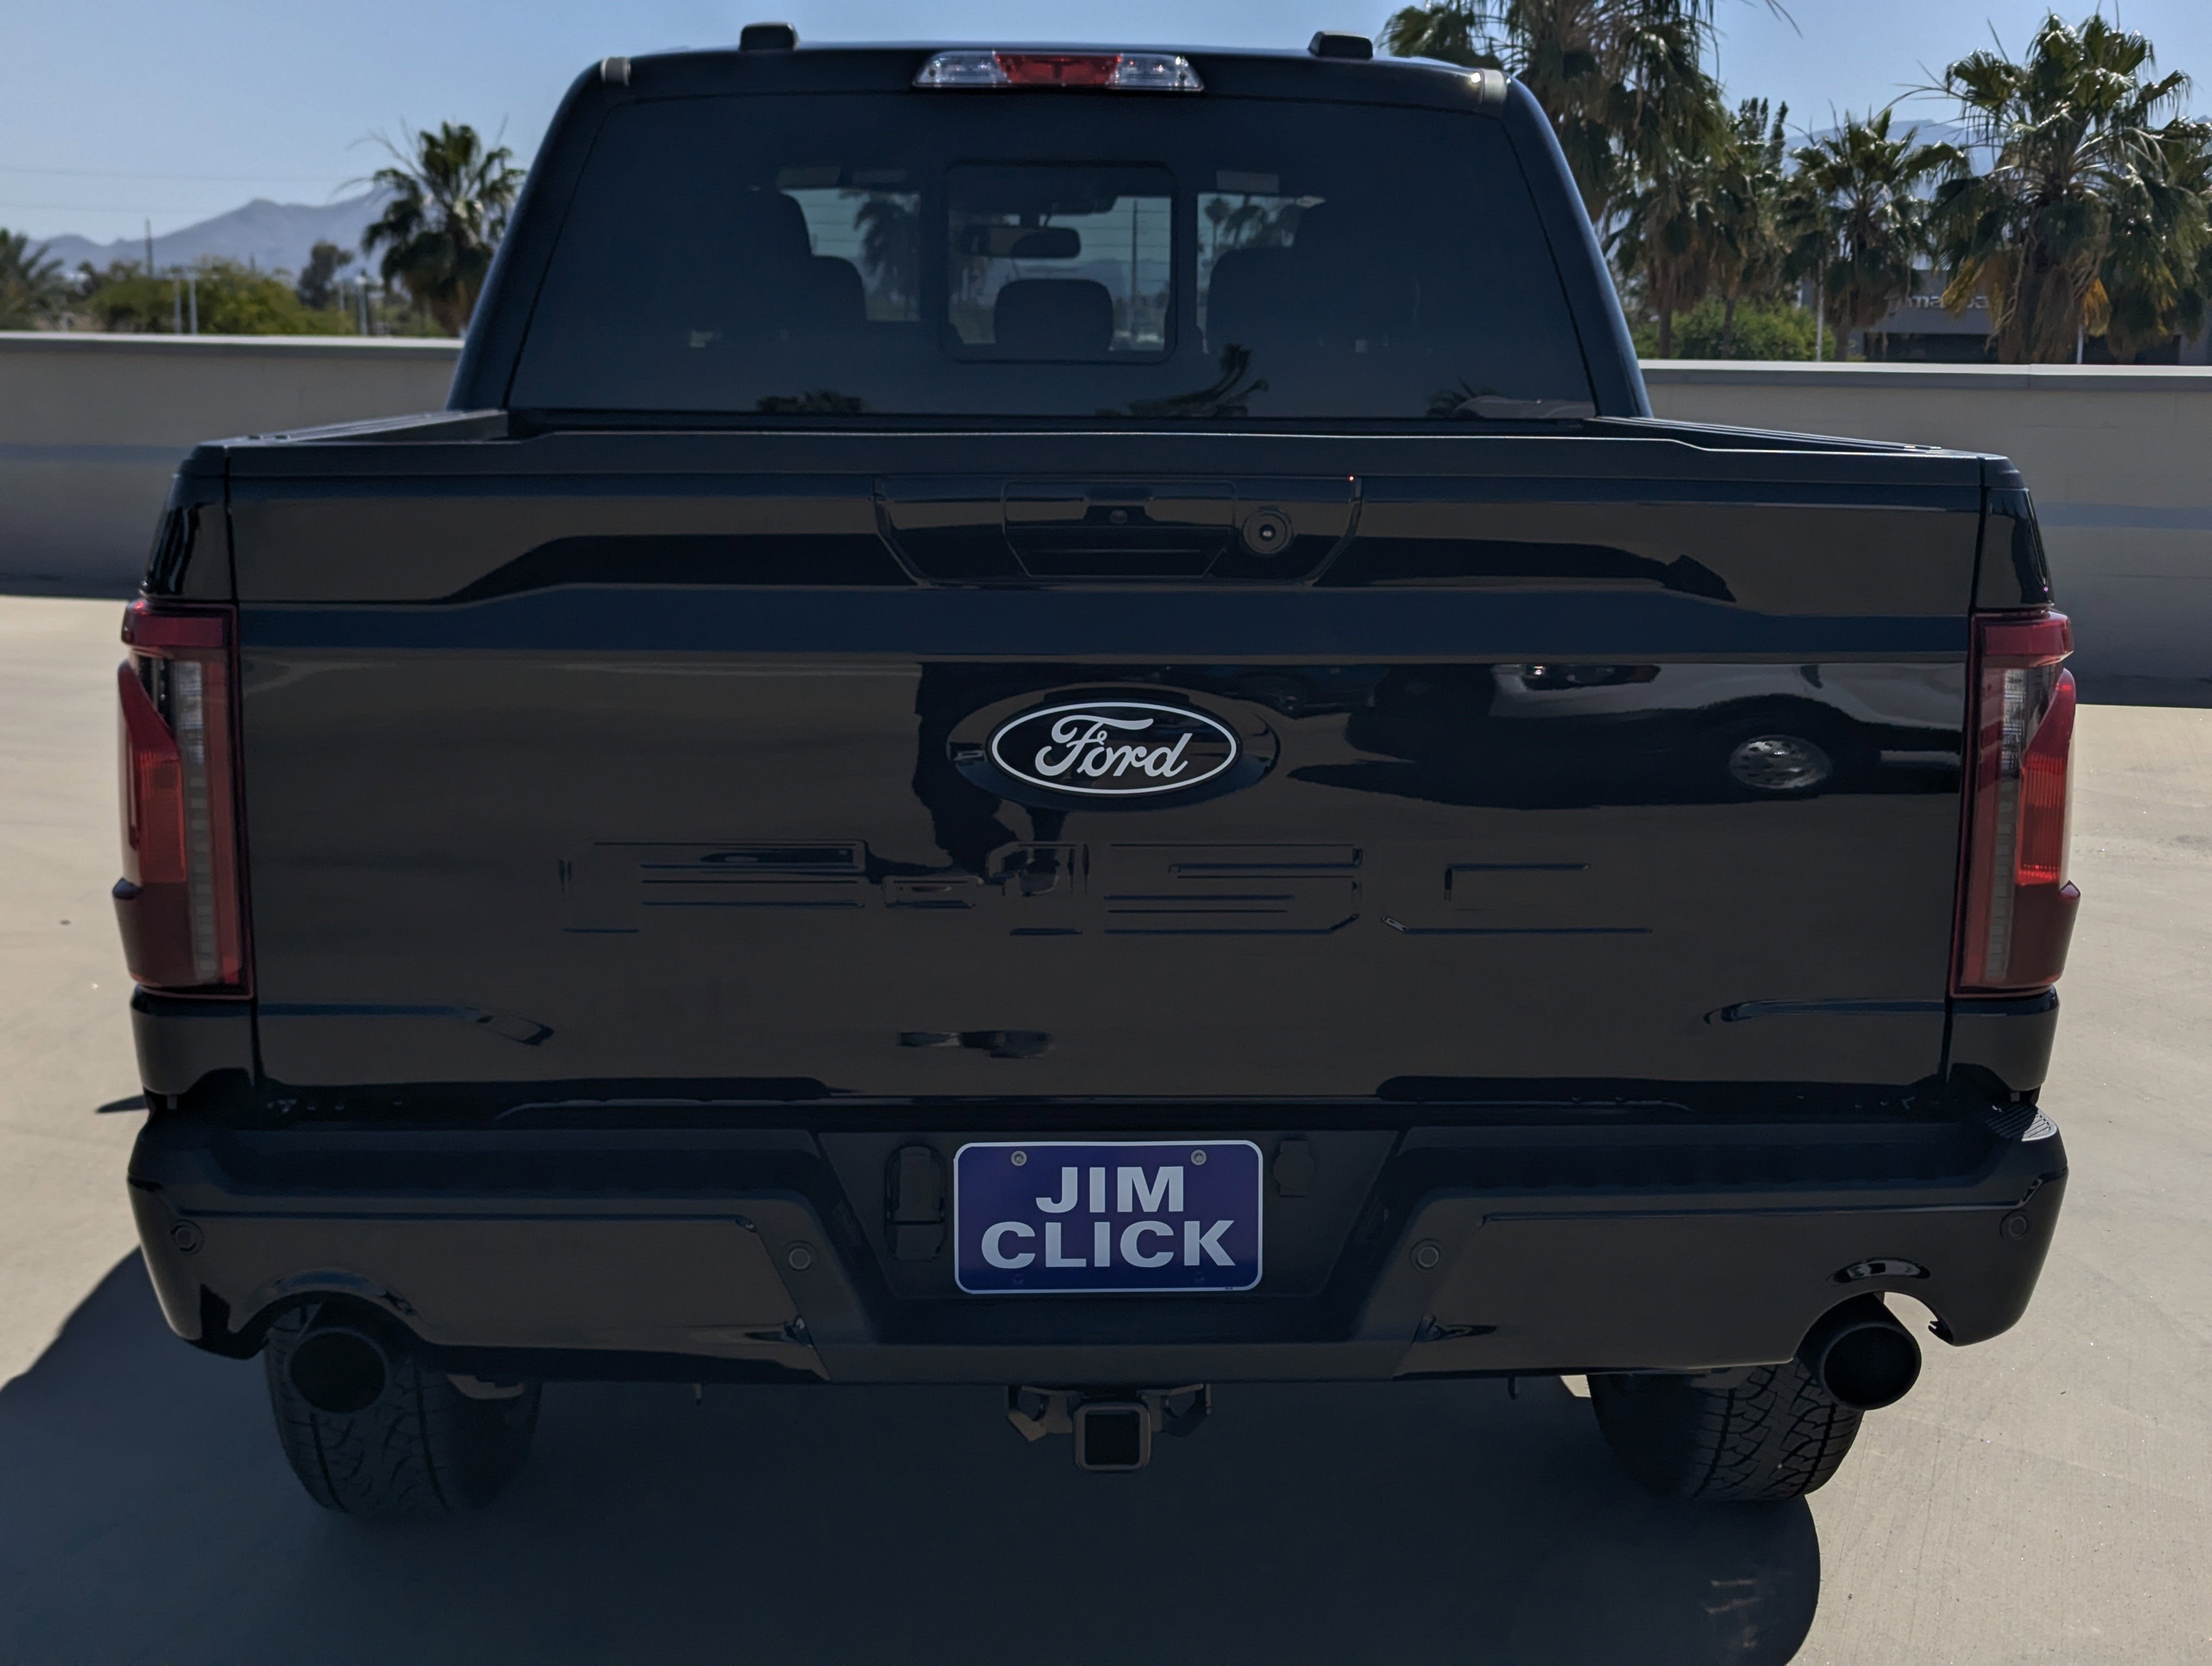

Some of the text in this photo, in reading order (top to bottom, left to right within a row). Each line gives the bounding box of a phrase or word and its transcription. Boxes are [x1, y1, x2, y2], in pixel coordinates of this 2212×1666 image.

[1909, 294, 1990, 309] maa
[1034, 715, 1193, 777] Ford
[1036, 1166, 1184, 1213] JIM
[981, 1220, 1236, 1269] CLICK
